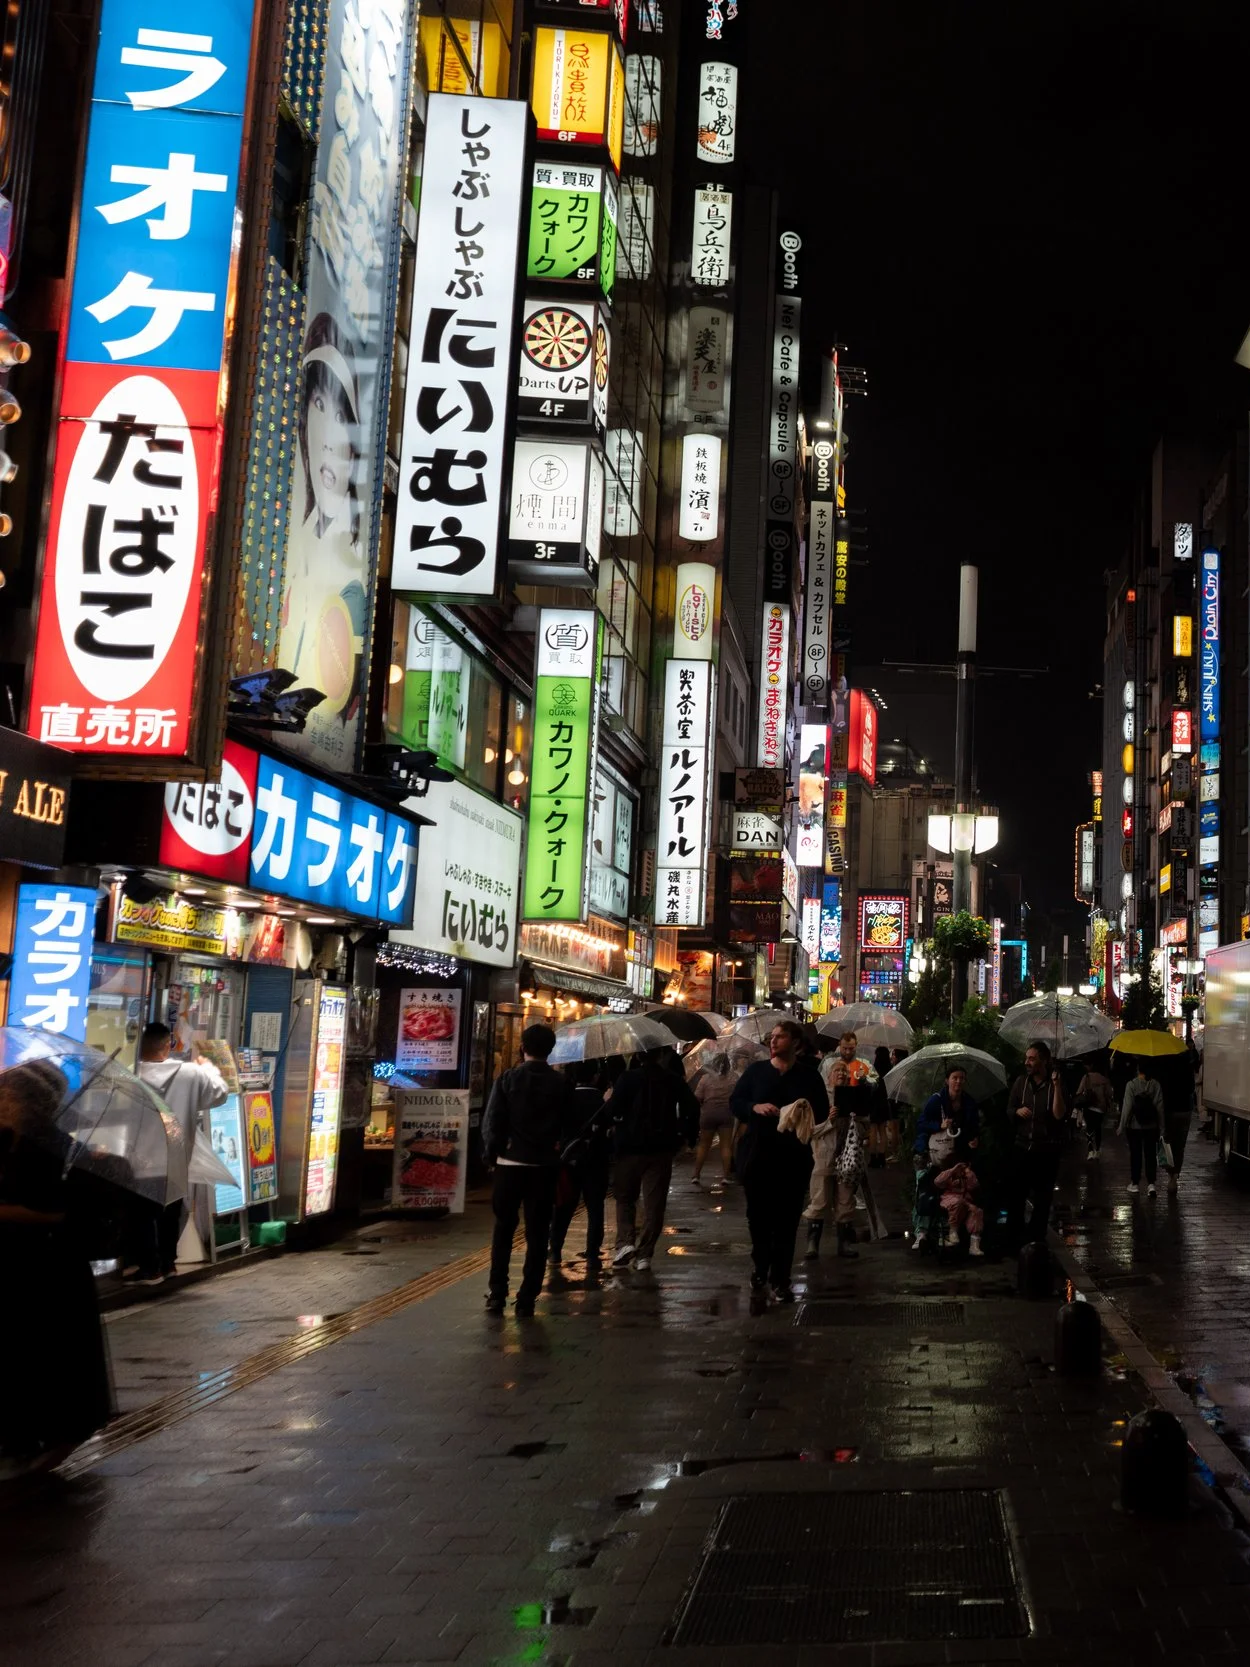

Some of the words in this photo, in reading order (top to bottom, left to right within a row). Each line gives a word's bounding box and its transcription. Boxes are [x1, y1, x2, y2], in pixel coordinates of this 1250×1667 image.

[557, 131, 577, 142] 6F
[445, 107, 492, 301] しゃぶしゃぶ
[576, 268, 596, 279] 5F
[779, 231, 802, 290] Booth
[782, 303, 795, 331] Net
[780, 334, 794, 371] Cafe
[519, 376, 556, 390] Darts
[557, 375, 589, 395] UP
[780, 376, 792, 386] &
[539, 399, 565, 417] 4F
[777, 391, 792, 453] Capsule
[410, 306, 498, 577] にいむら
[814, 441, 834, 492] Booth
[73, 412, 185, 661] たばこ
[533, 542, 557, 560] 3F
[816, 508, 828, 572] ネットカフェ
[814, 577, 824, 588] &
[812, 592, 824, 636] カプセル
[767, 617, 784, 673] カラオケ
[39, 702, 178, 748] 直売所
[549, 709, 577, 717] QUARK
[677, 669, 696, 740] 喫茶室
[13, 779, 66, 826] ALE
[666, 748, 699, 858] ルノアール
[771, 814, 782, 823] 3F
[830, 790, 844, 816] 麻雀
[250, 773, 418, 913] カラオケ
[736, 830, 779, 843] DAN
[826, 830, 844, 873] CASINO
[665, 870, 681, 924] 磯丸水産
[441, 888, 509, 952] にいむら
[407, 992, 455, 1003] すき焼き
[404, 1094, 462, 1107] NIIMURA
